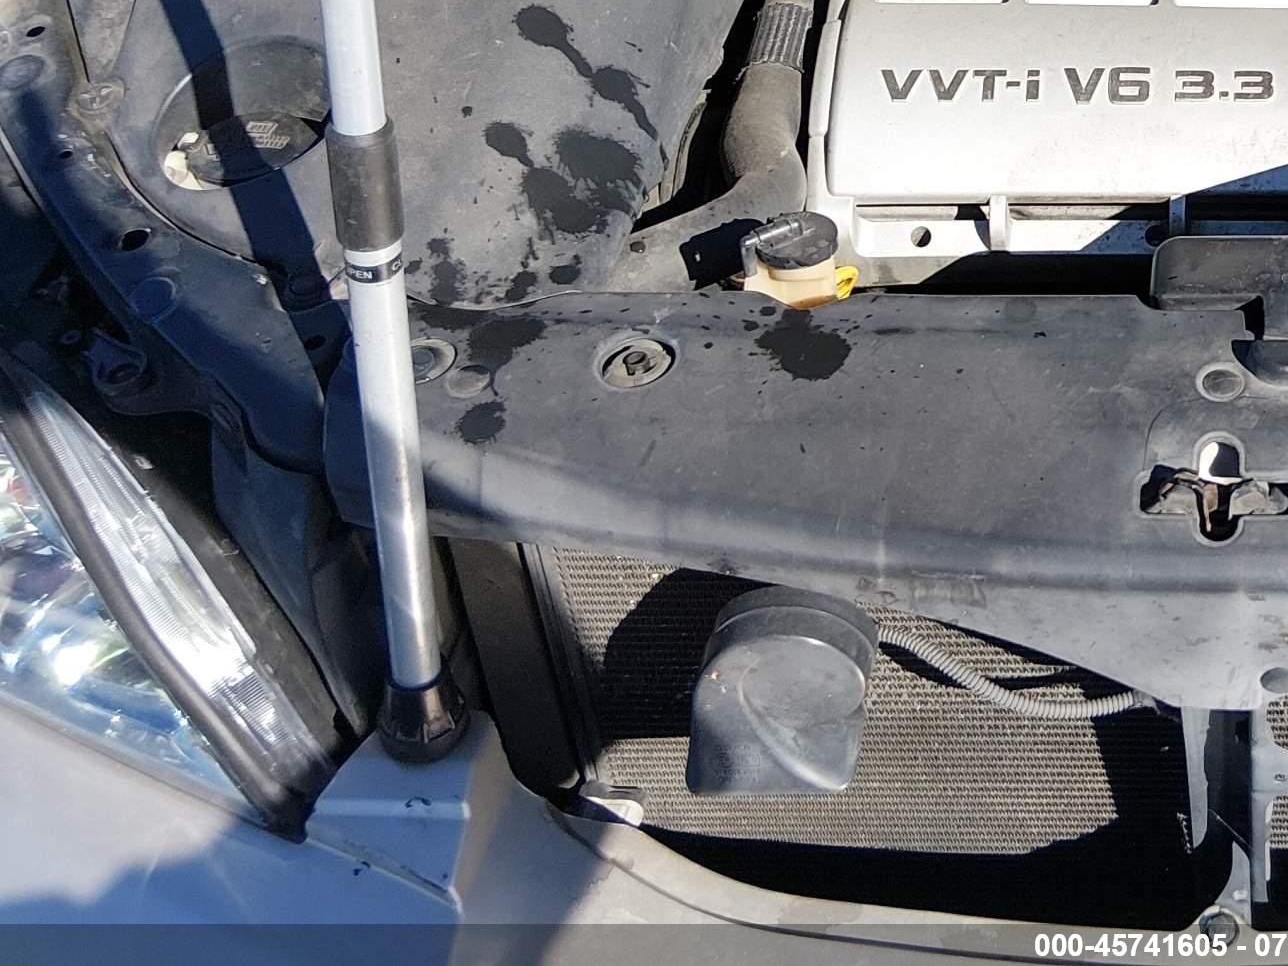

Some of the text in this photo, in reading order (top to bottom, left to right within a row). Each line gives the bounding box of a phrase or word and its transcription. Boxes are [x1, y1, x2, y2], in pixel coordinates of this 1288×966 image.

[880, 66, 1275, 106] VVT-i V6 3.3
